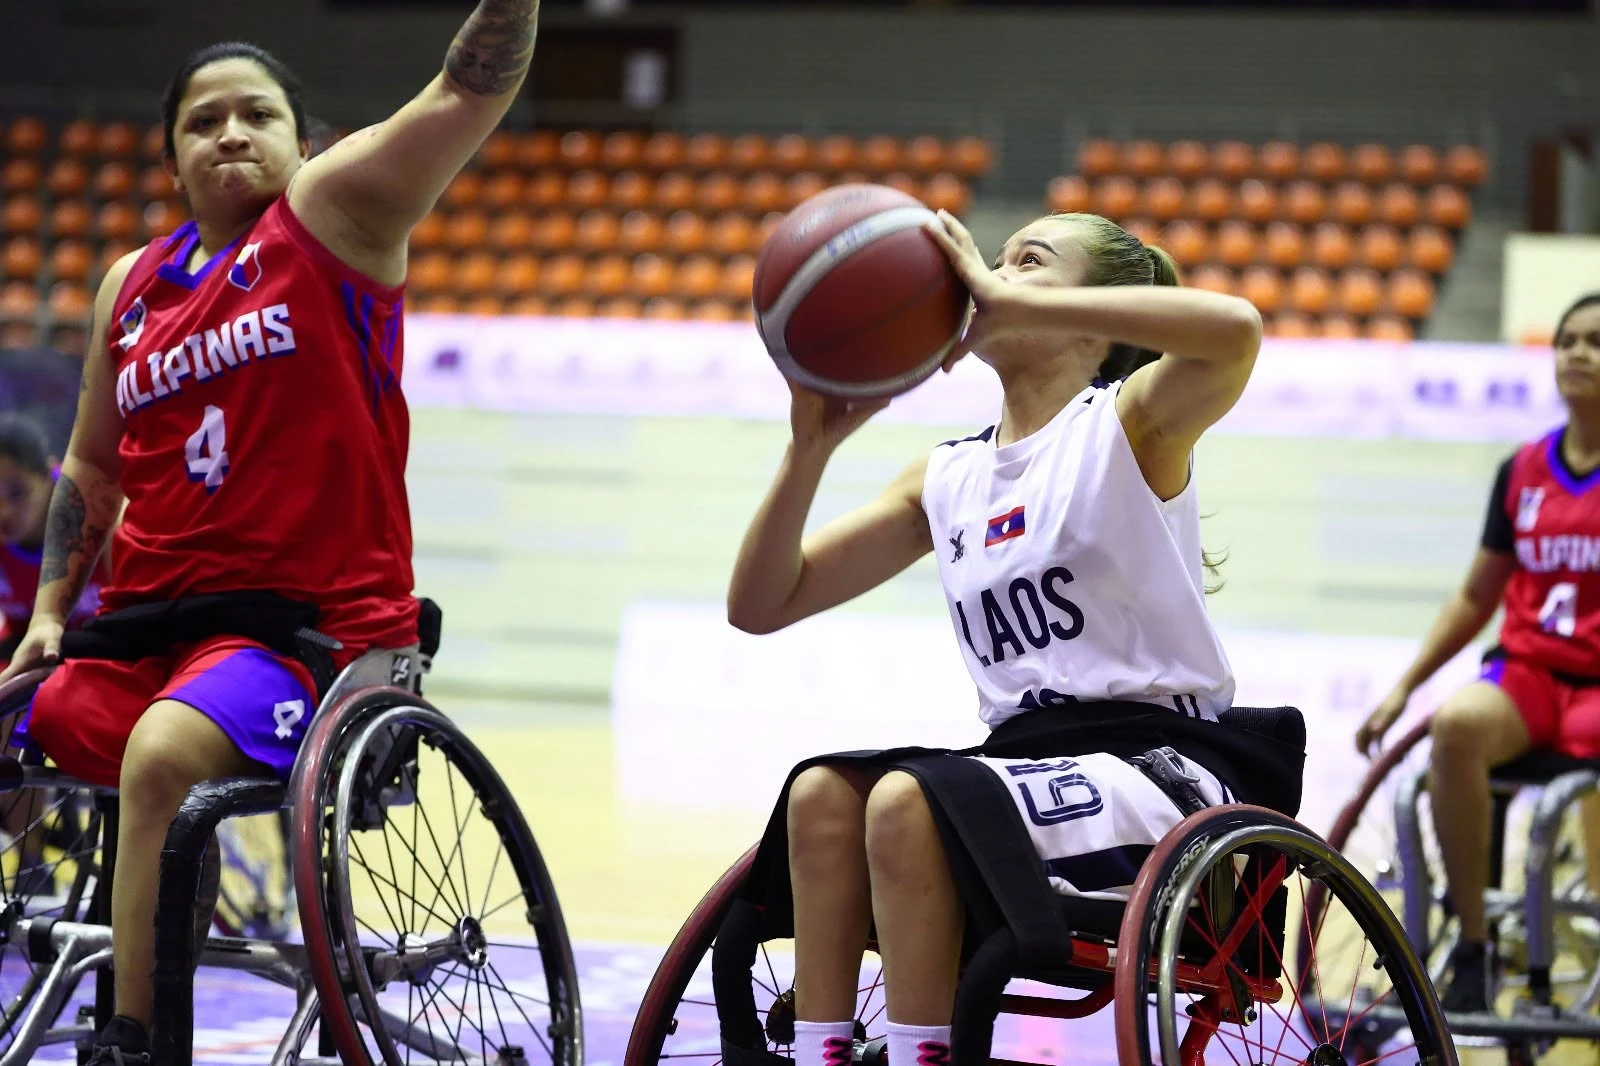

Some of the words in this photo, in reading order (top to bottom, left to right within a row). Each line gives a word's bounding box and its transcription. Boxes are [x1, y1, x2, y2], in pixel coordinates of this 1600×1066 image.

[184, 404, 230, 495] 4
[956, 566, 1085, 668] LAOS
[1536, 581, 1577, 638] 4
[272, 699, 305, 740] 4
[1004, 759, 1104, 827] 19
